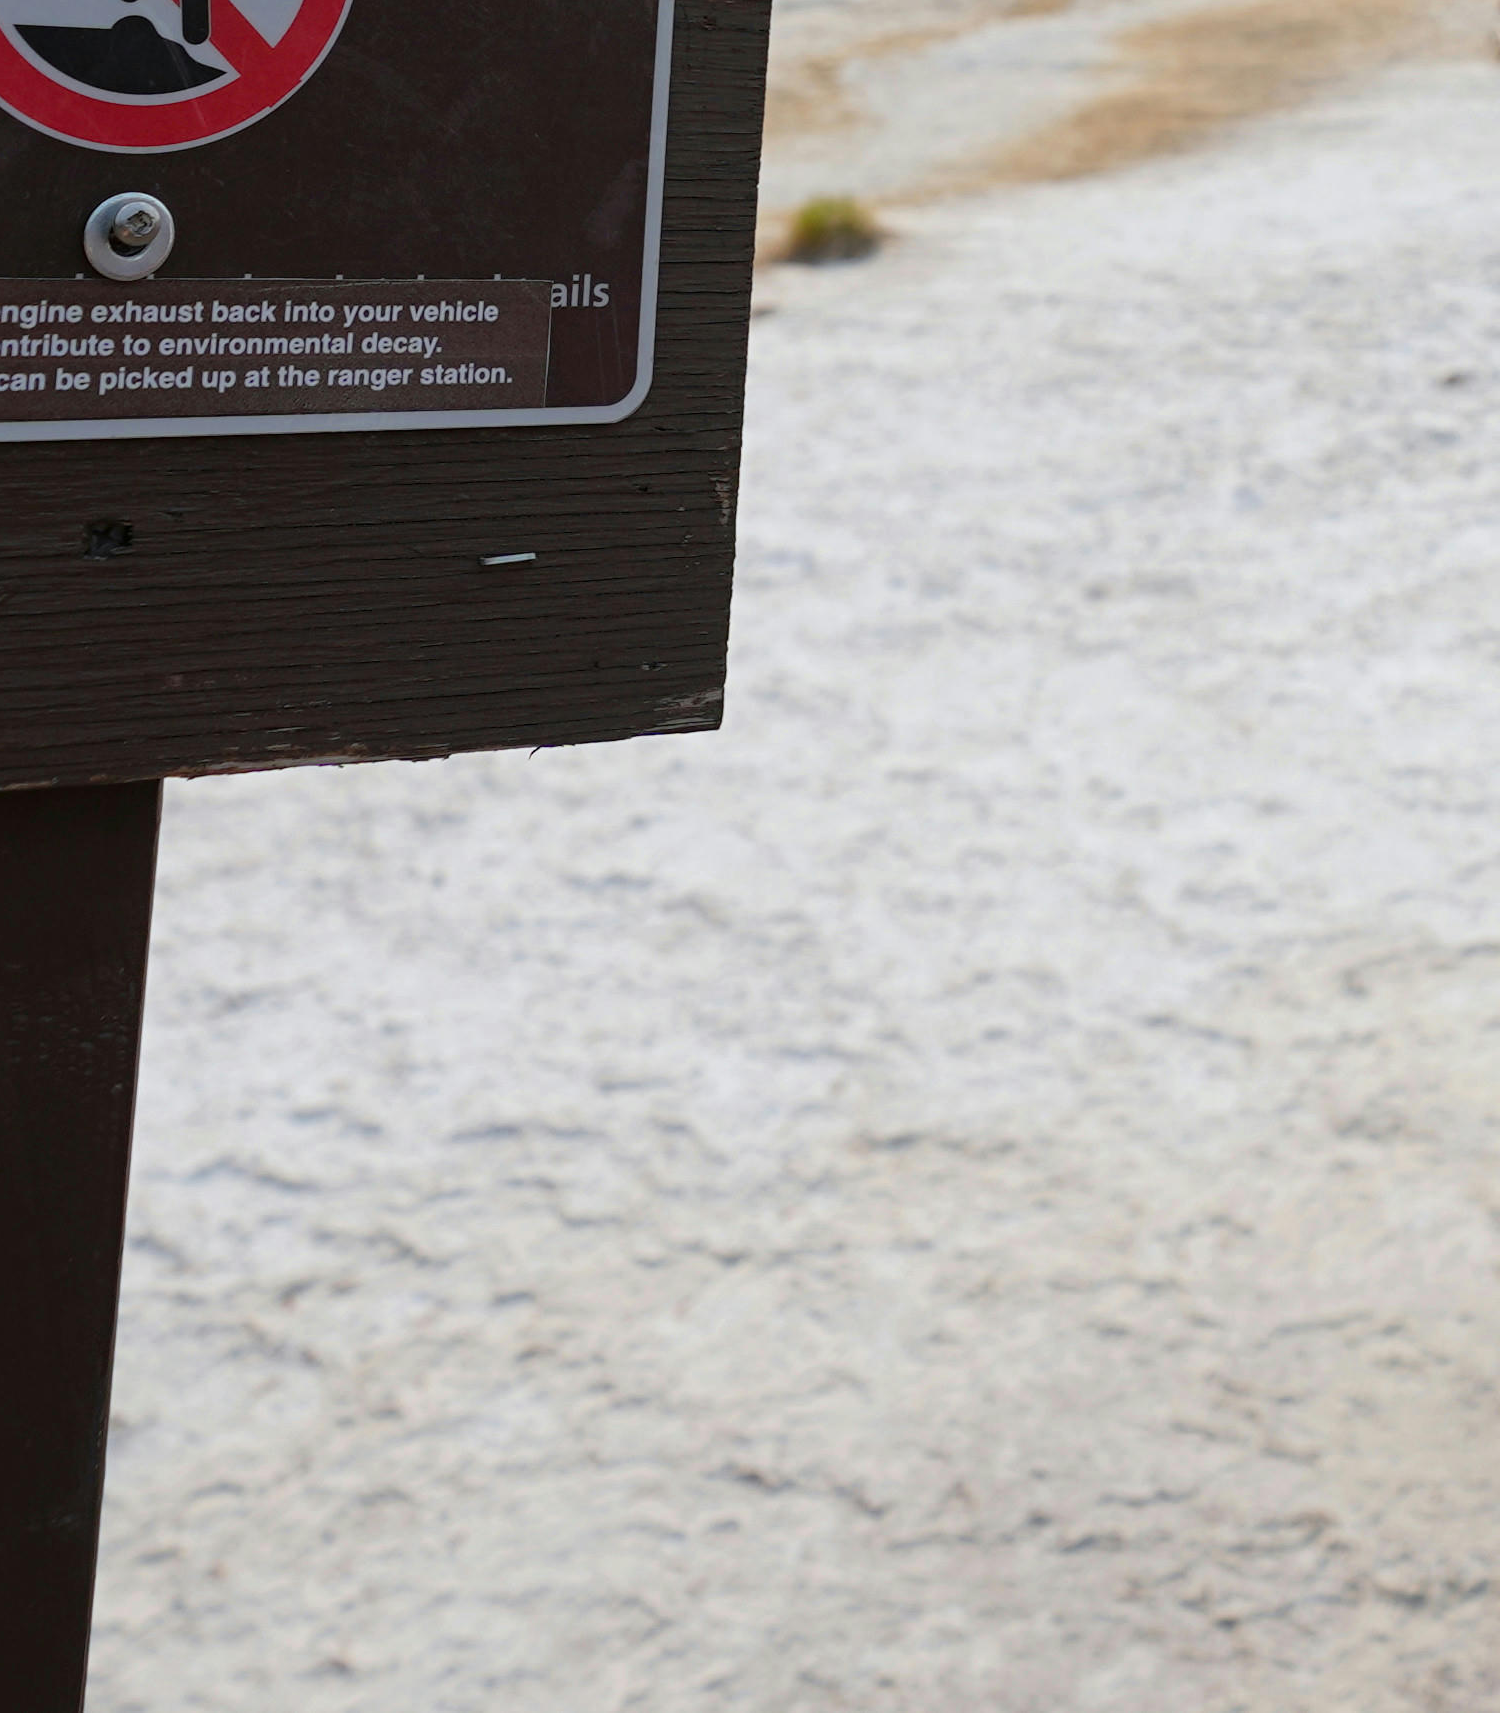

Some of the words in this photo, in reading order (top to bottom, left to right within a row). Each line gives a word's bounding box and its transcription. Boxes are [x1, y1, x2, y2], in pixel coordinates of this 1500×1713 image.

[90, 300, 204, 323] exhaust
[211, 300, 278, 323] back
[283, 300, 336, 323] into
[342, 305, 404, 328] your
[409, 300, 500, 323] vehicle
[122, 334, 152, 356] to
[157, 332, 354, 356] environmental
[360, 332, 443, 359] decay.
[54, 367, 92, 391] be
[98, 366, 194, 396] picked
[201, 369, 238, 393] up
[243, 365, 272, 388] at
[276, 365, 322, 387] the
[326, 368, 415, 392] ranger
[419, 362, 514, 386] station.
